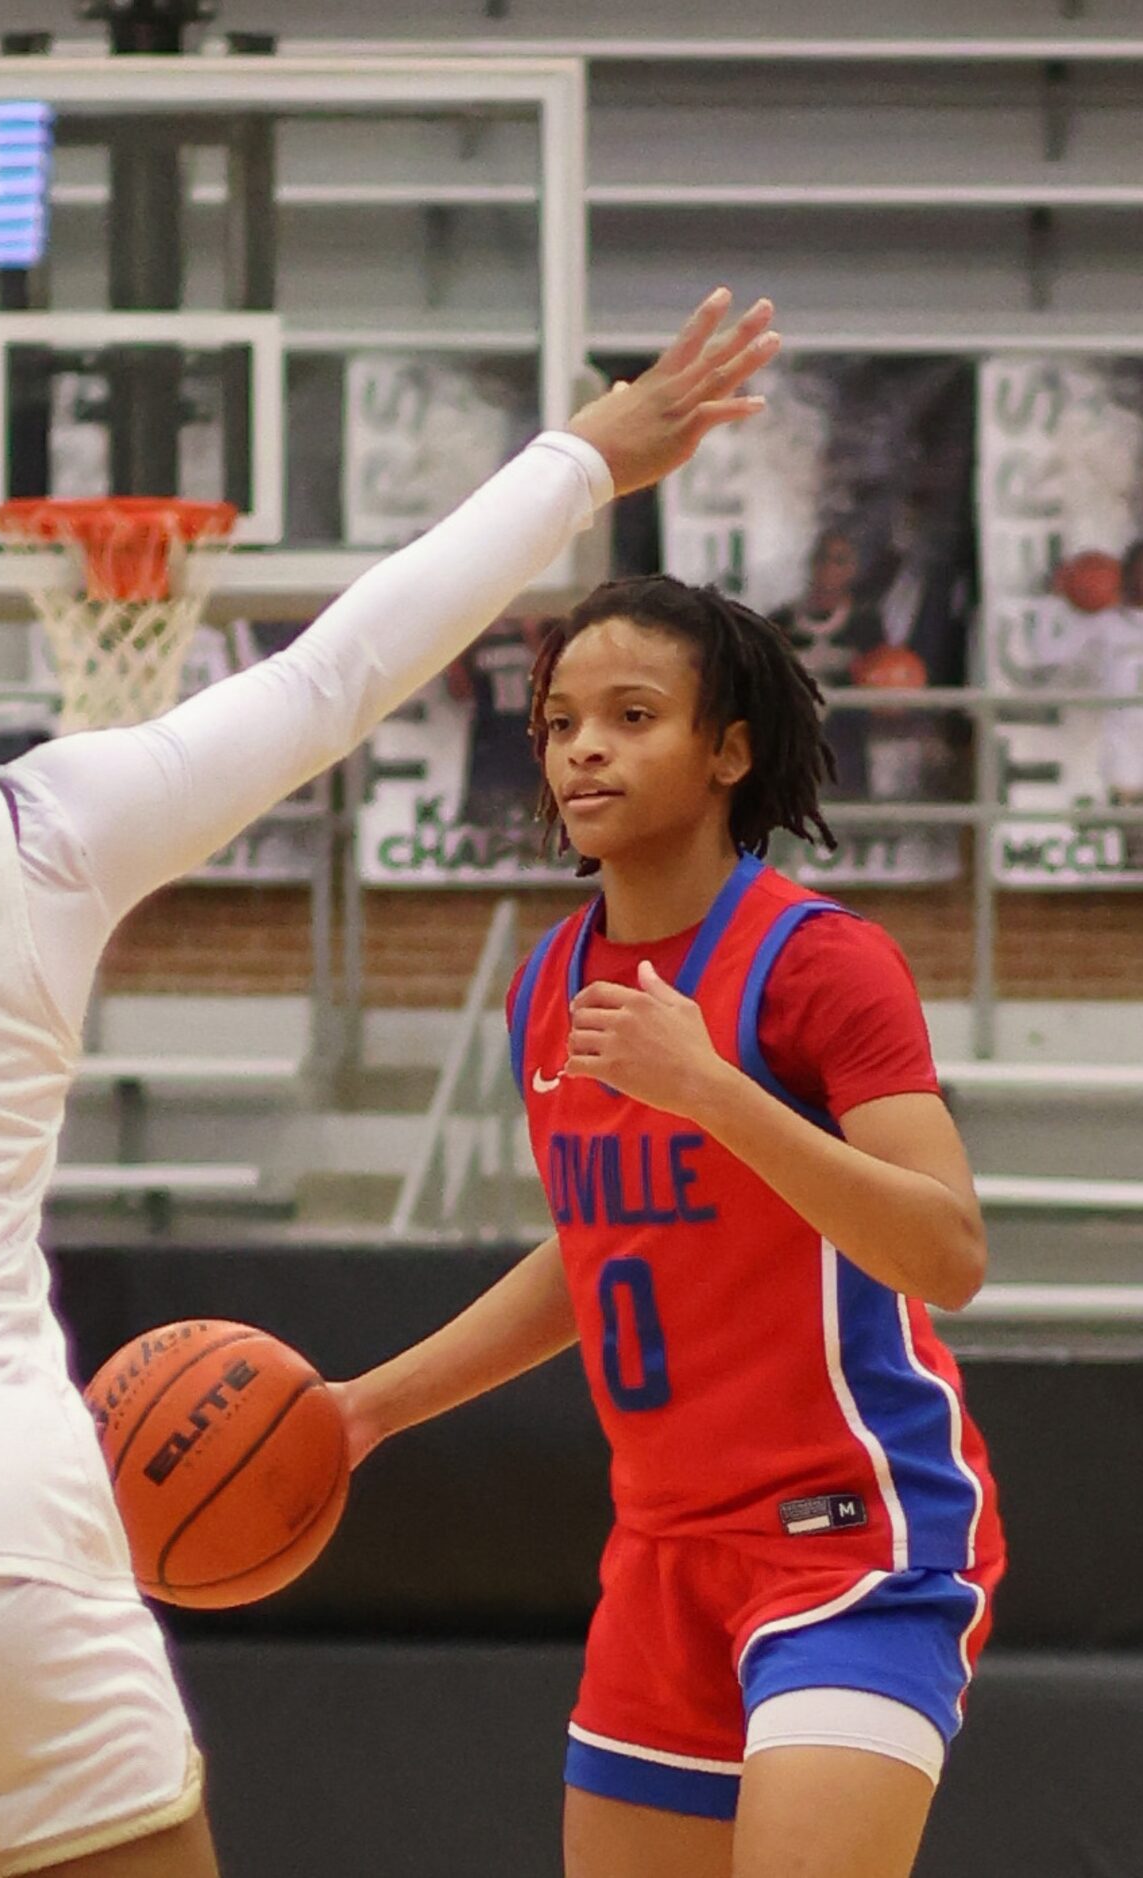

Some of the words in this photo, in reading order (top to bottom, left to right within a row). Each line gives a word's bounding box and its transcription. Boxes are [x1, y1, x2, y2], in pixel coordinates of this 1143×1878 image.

[599, 1256, 672, 1413] 0
[143, 1358, 258, 1487] ELITE
[838, 1501, 856, 1518] M
